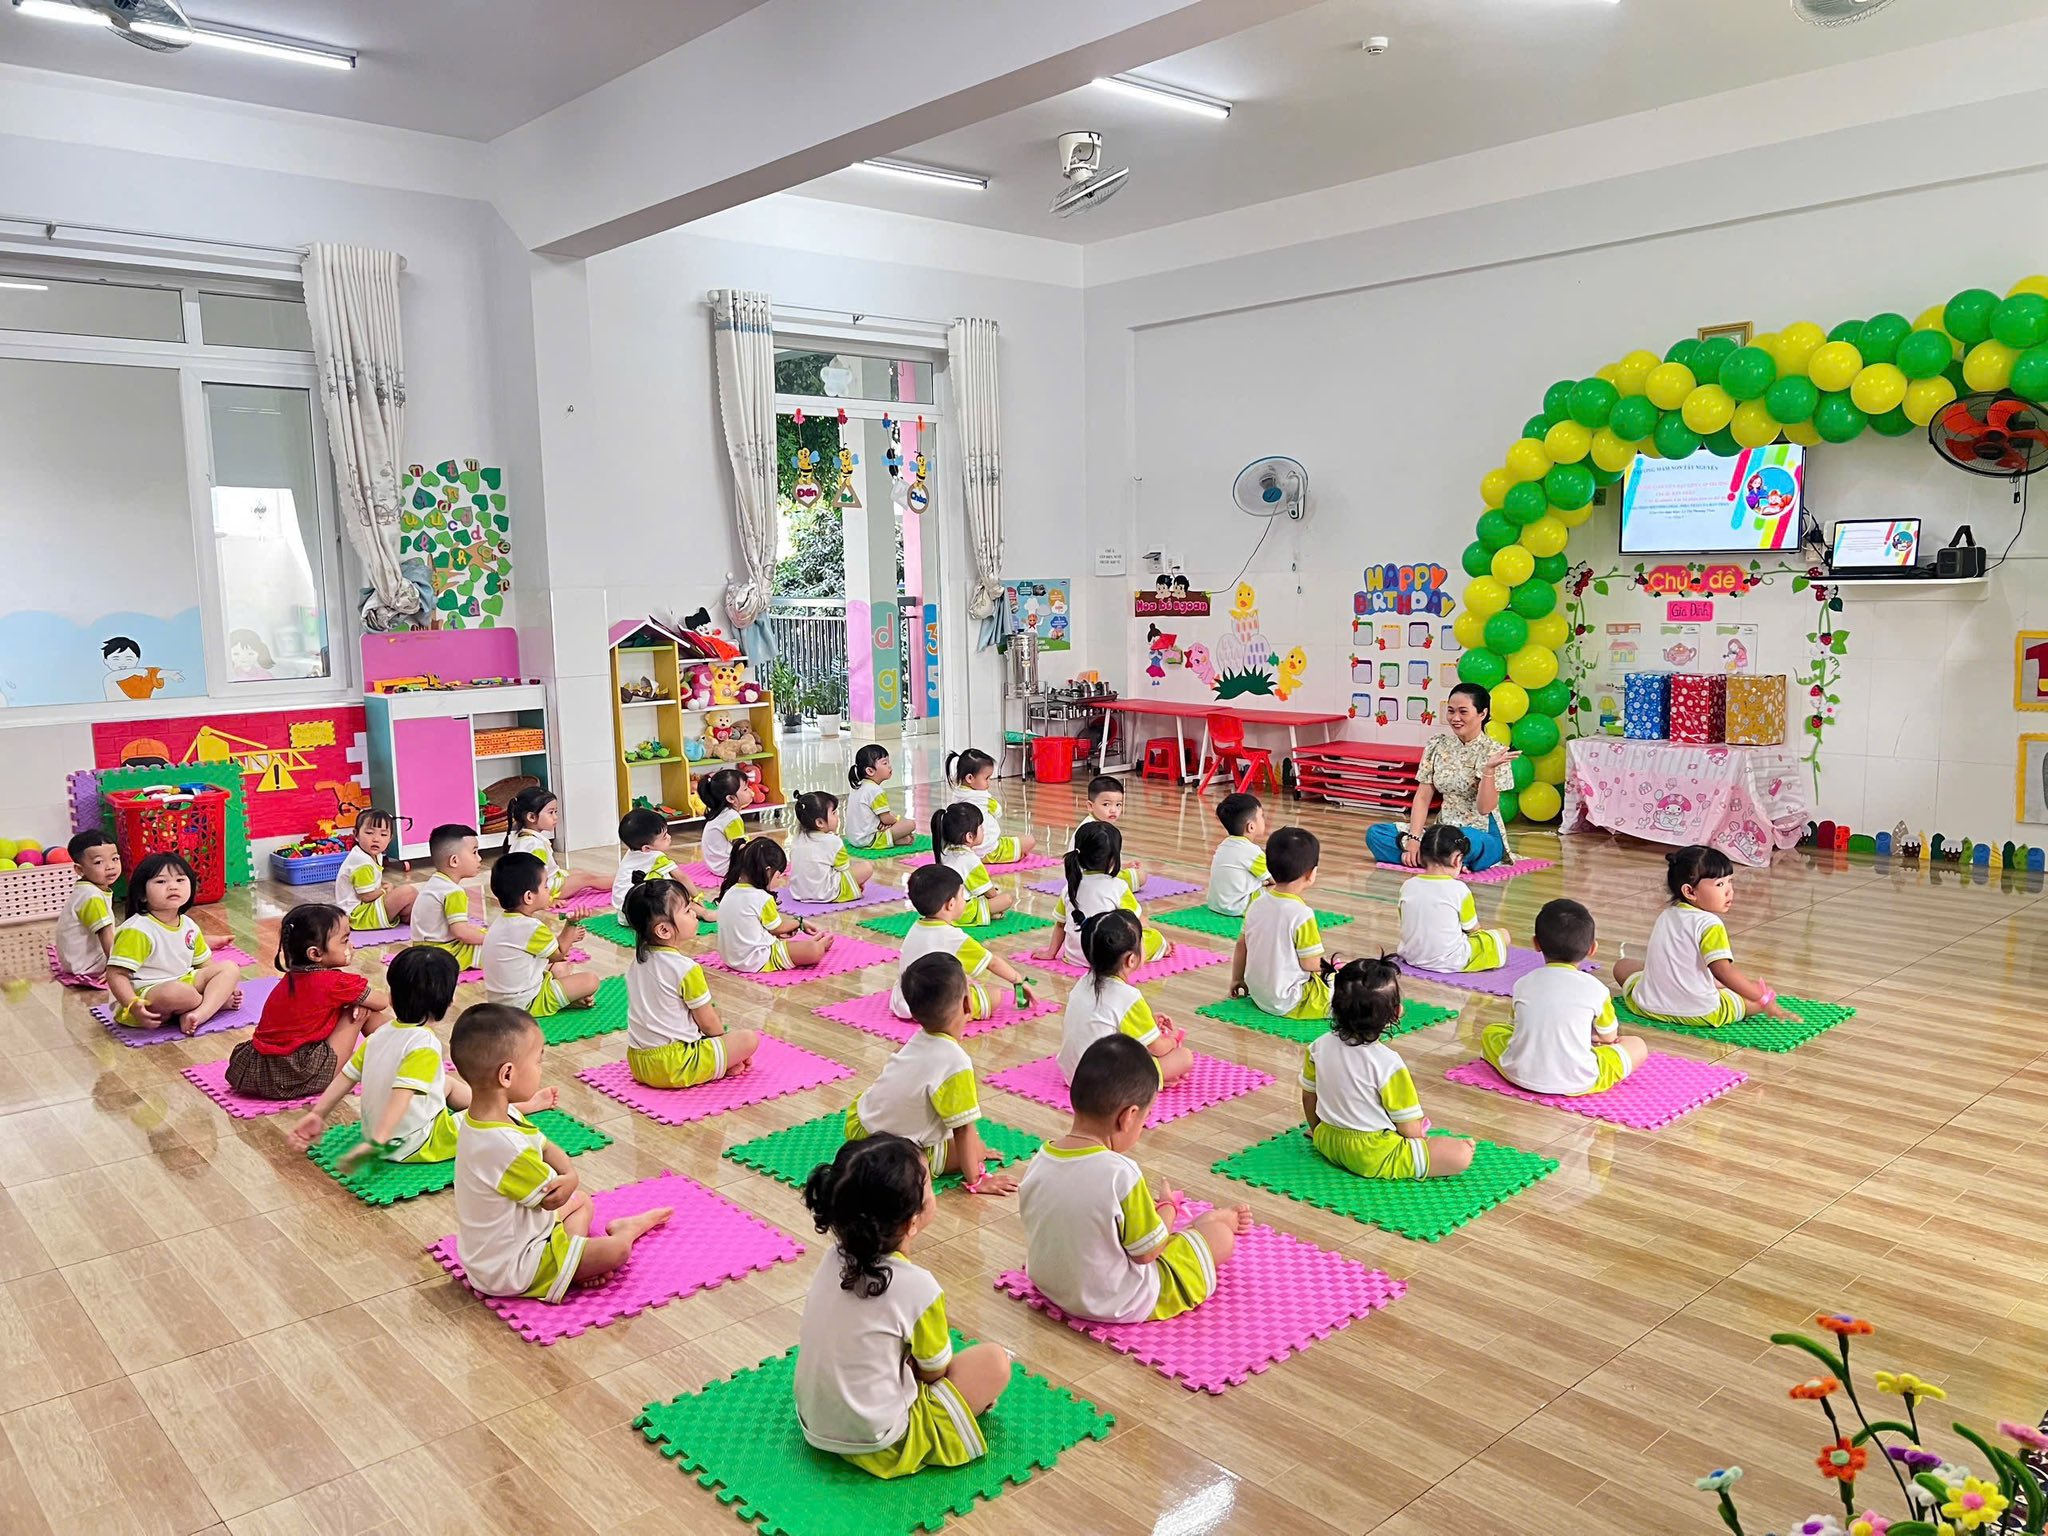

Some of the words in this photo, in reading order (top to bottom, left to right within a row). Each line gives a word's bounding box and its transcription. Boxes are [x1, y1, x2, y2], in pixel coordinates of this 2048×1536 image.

[1365, 564, 1447, 592] HAPPY
[1650, 571, 1688, 591] Chủ
[1709, 567, 1737, 589] đề
[1173, 601, 1208, 614] ngoan
[875, 612, 894, 649] d
[878, 668, 898, 711] g
[927, 664, 938, 699] 5
